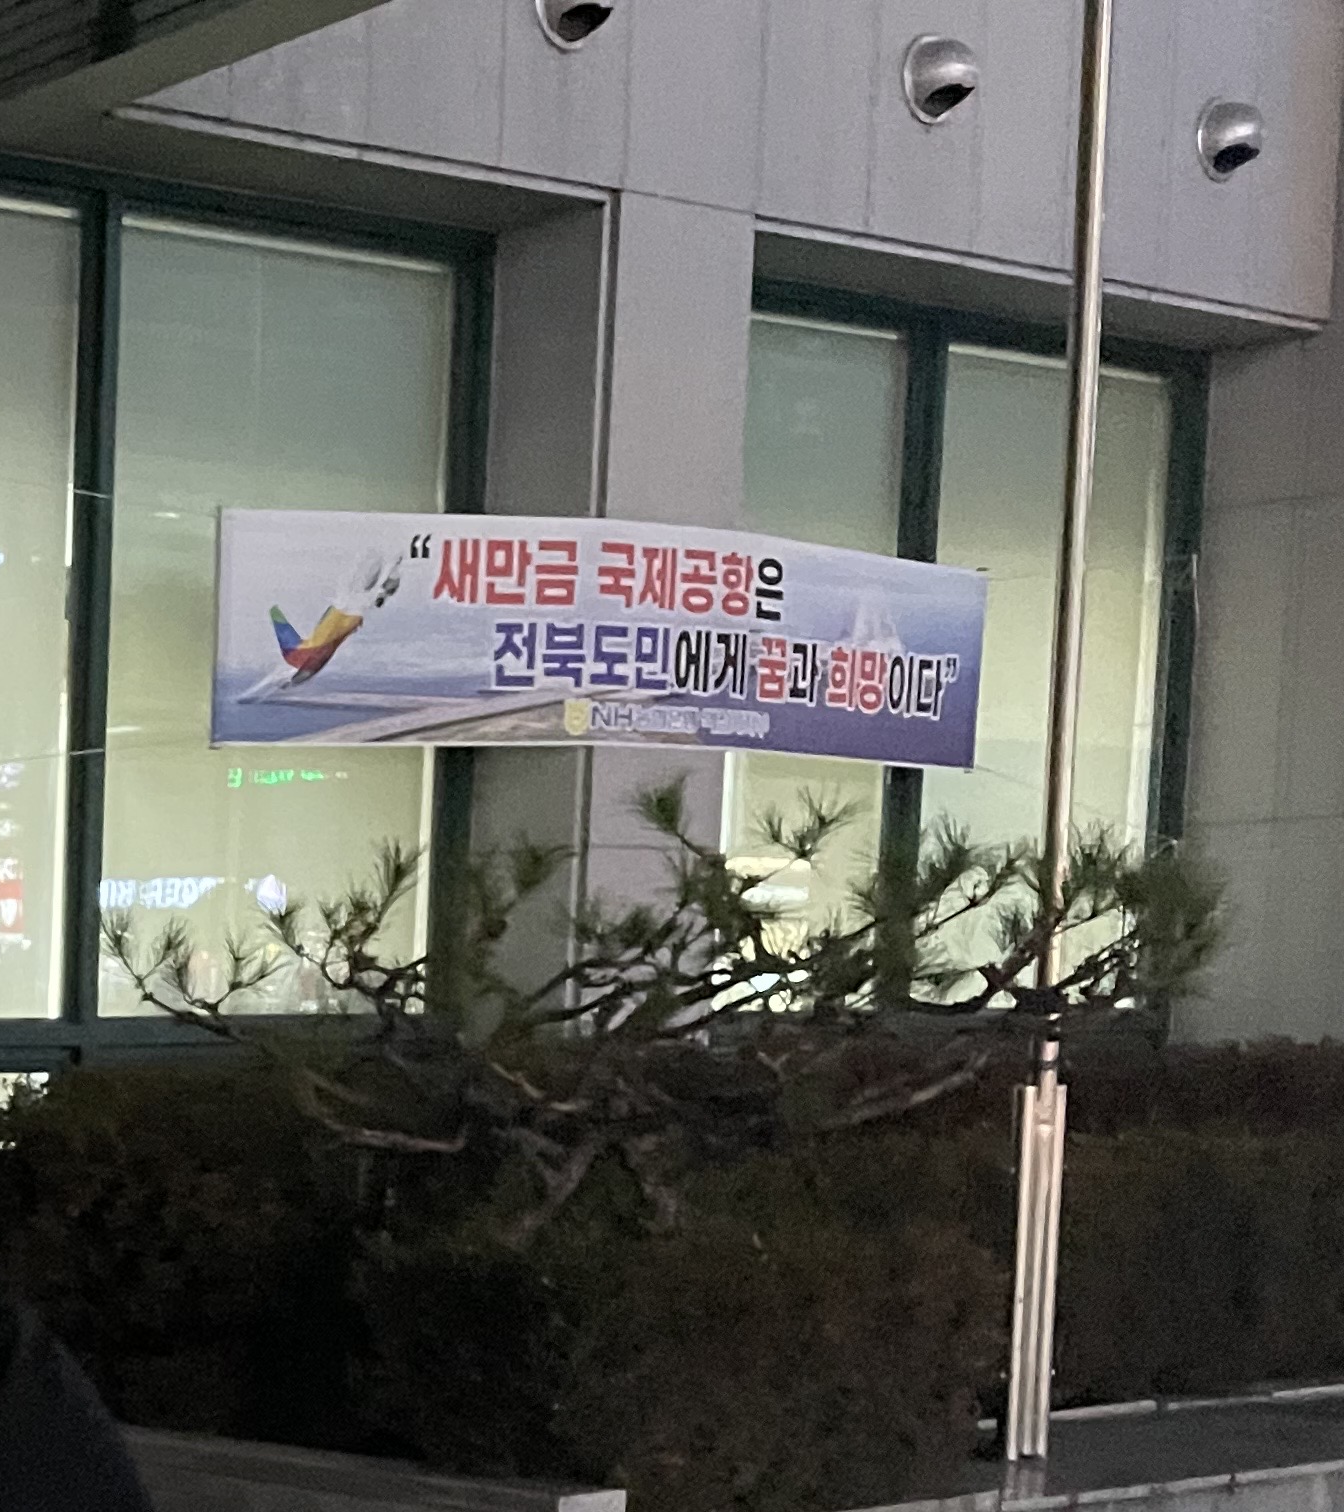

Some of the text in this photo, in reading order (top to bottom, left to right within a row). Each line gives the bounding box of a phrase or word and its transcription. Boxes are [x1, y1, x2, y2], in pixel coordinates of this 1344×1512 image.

[409, 534, 784, 622] “새만금 국제공항은
[493, 621, 960, 718] 전북도민에게 꿈과 희망이다”
